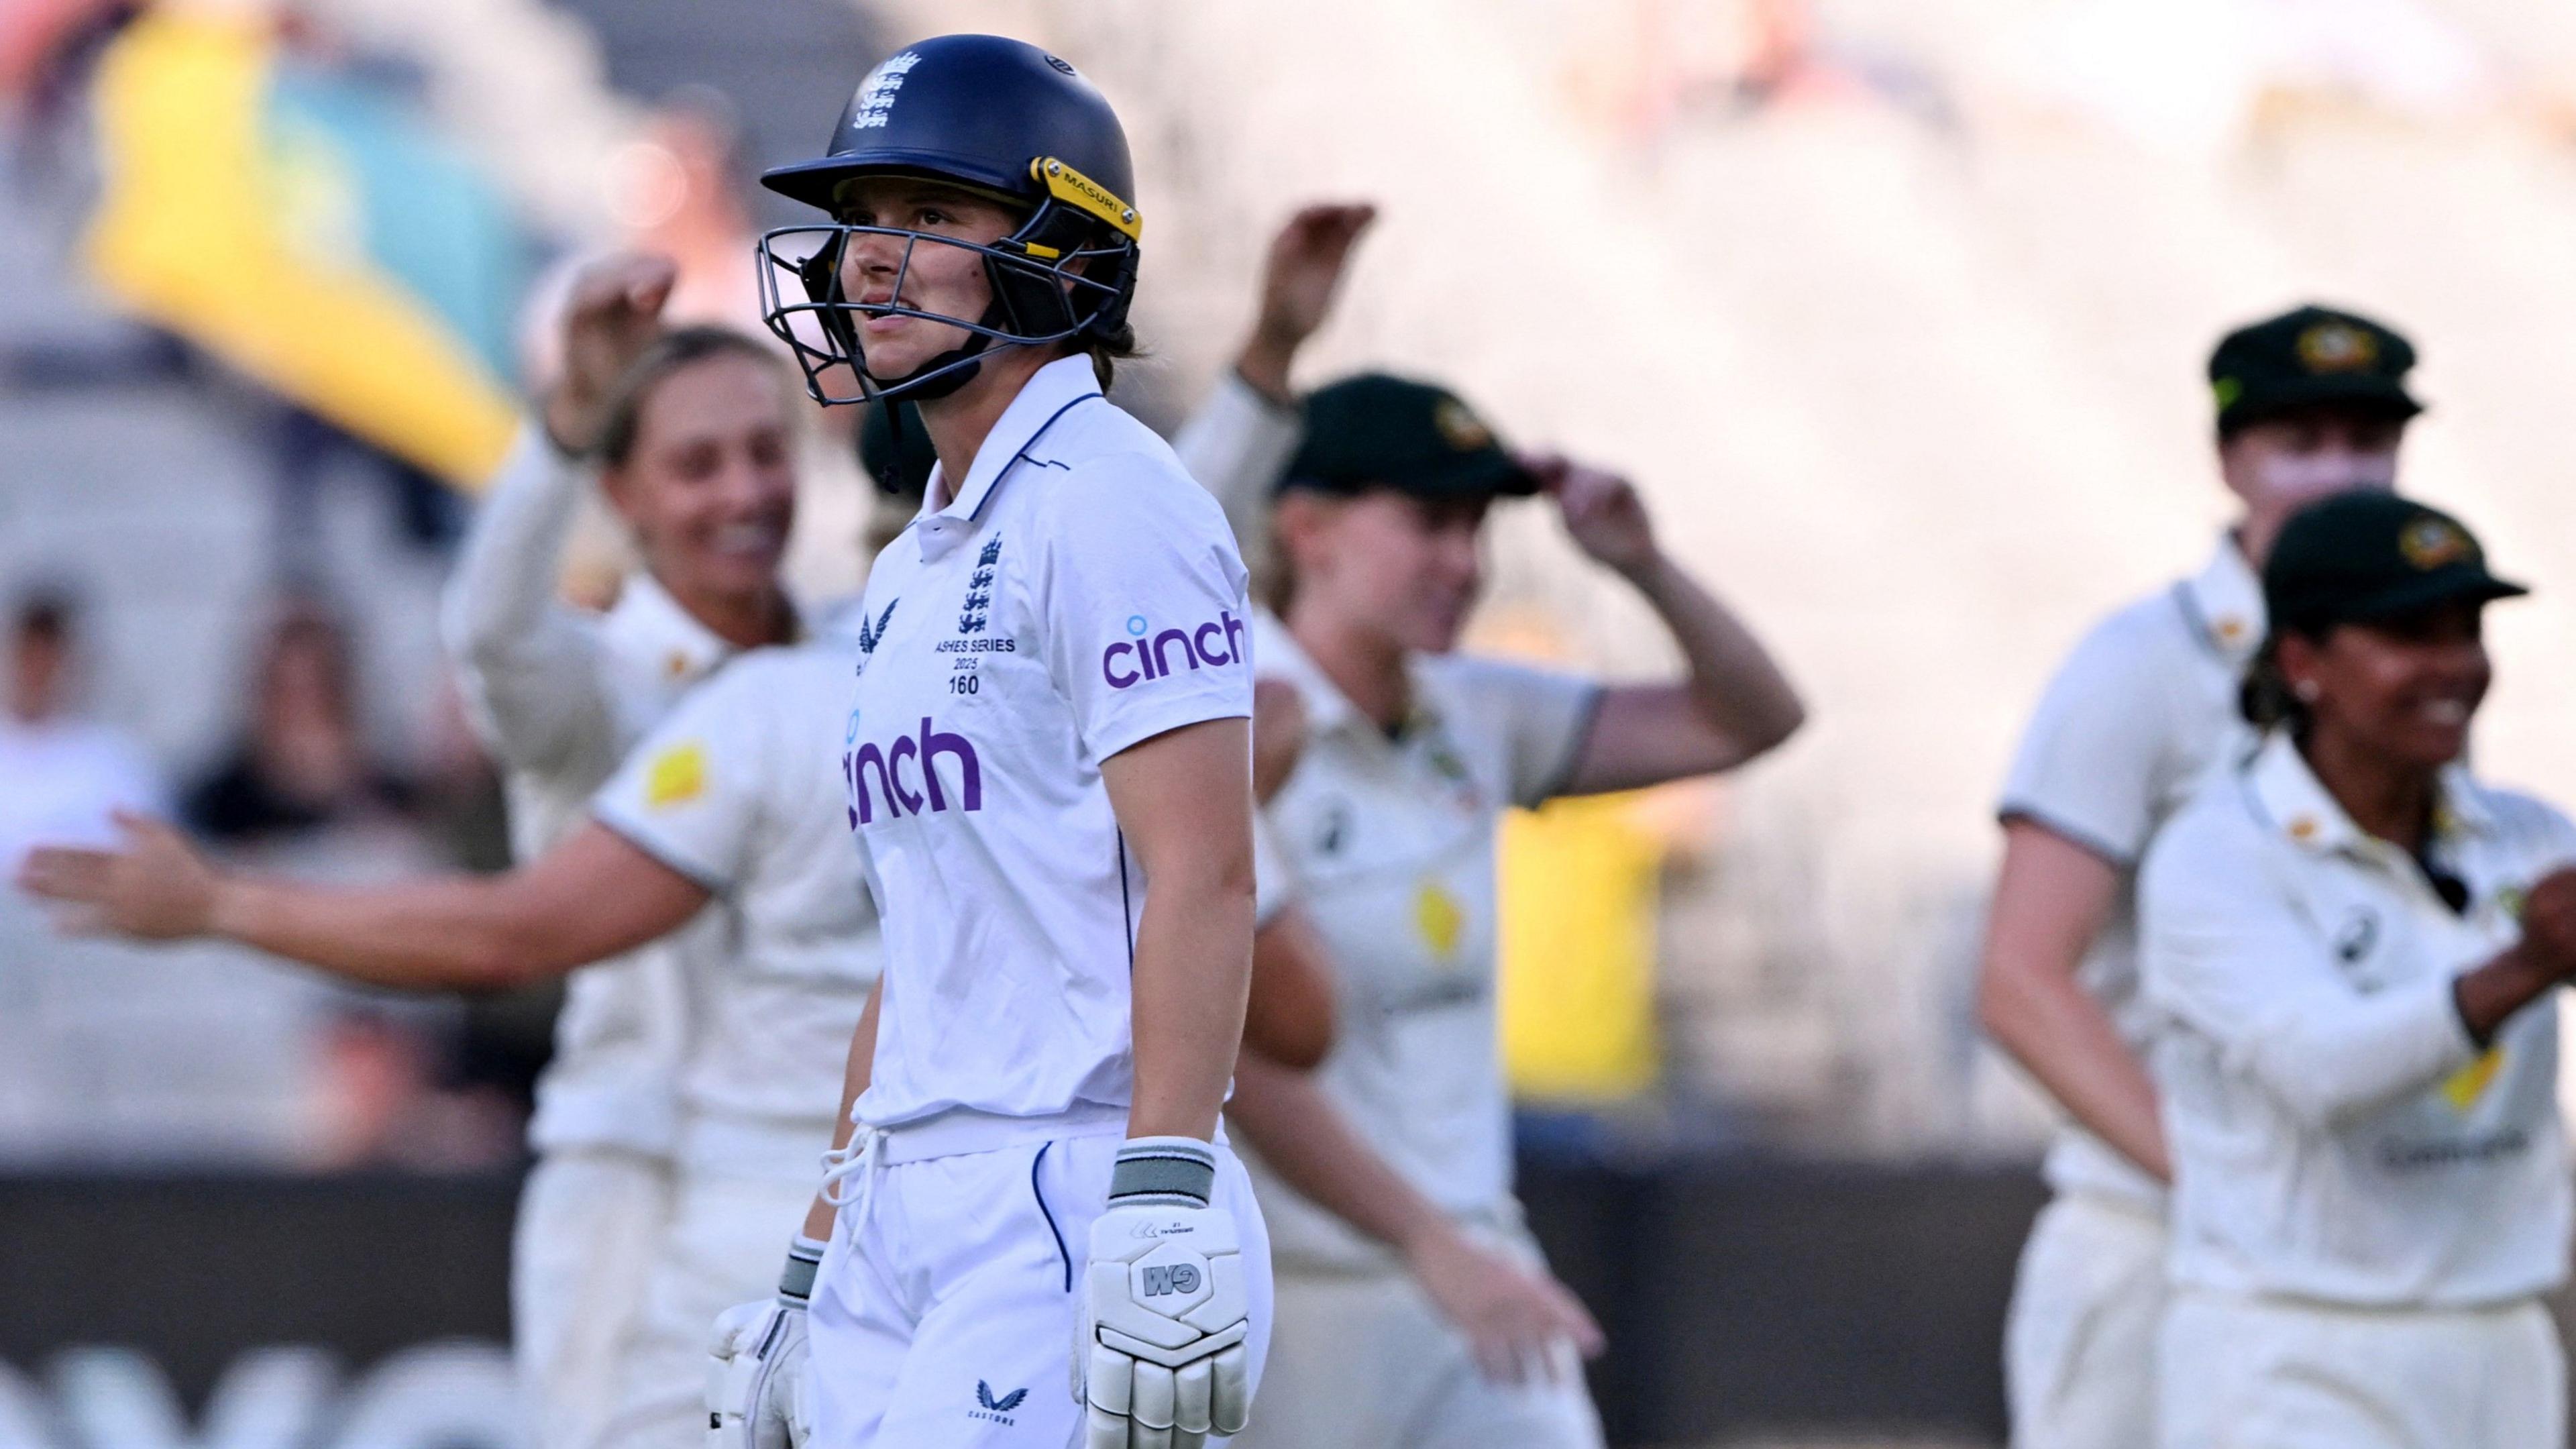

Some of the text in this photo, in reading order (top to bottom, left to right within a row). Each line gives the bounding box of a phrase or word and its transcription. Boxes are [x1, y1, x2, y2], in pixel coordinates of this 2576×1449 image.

[1064, 173, 1117, 212] MASURI
[935, 639, 1016, 653] ASHES SERIES
[1104, 611, 1246, 688] cinch
[953, 657, 978, 669] 2025
[949, 675, 979, 694] 160
[1142, 1263, 1201, 1297] GM
